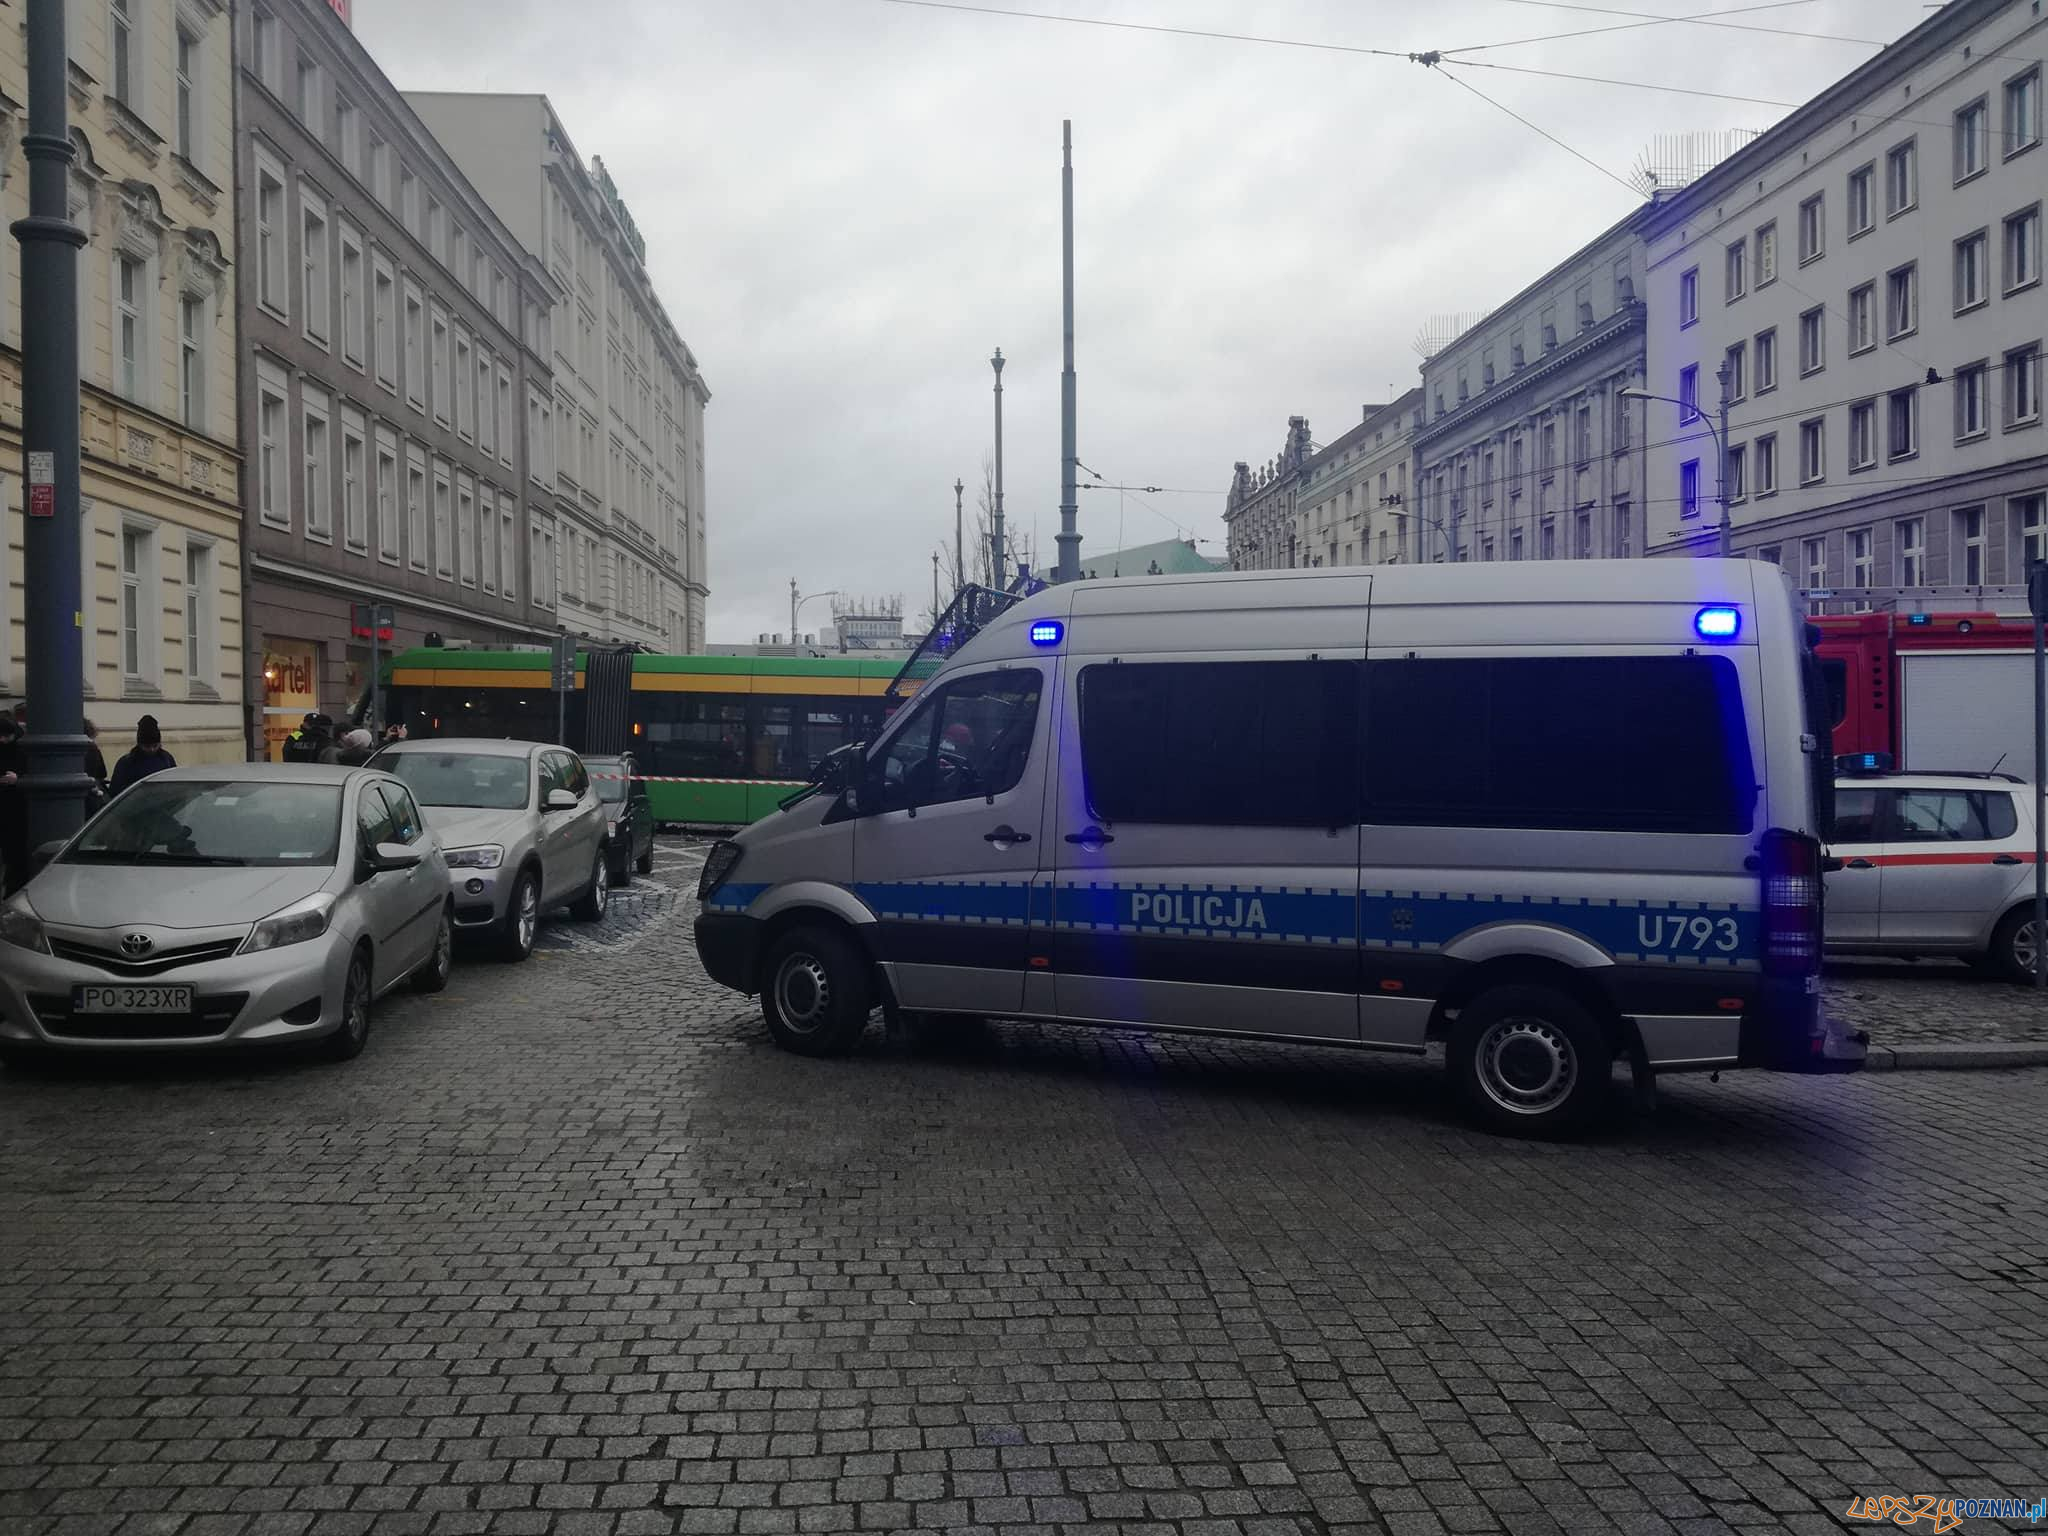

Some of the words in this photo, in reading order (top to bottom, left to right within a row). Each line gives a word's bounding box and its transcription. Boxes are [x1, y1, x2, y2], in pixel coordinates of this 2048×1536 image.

[1131, 892, 1267, 929] POLICJA
[1638, 914, 1740, 952] U793
[86, 989, 116, 1008] PO
[123, 989, 188, 1008] 323XR
